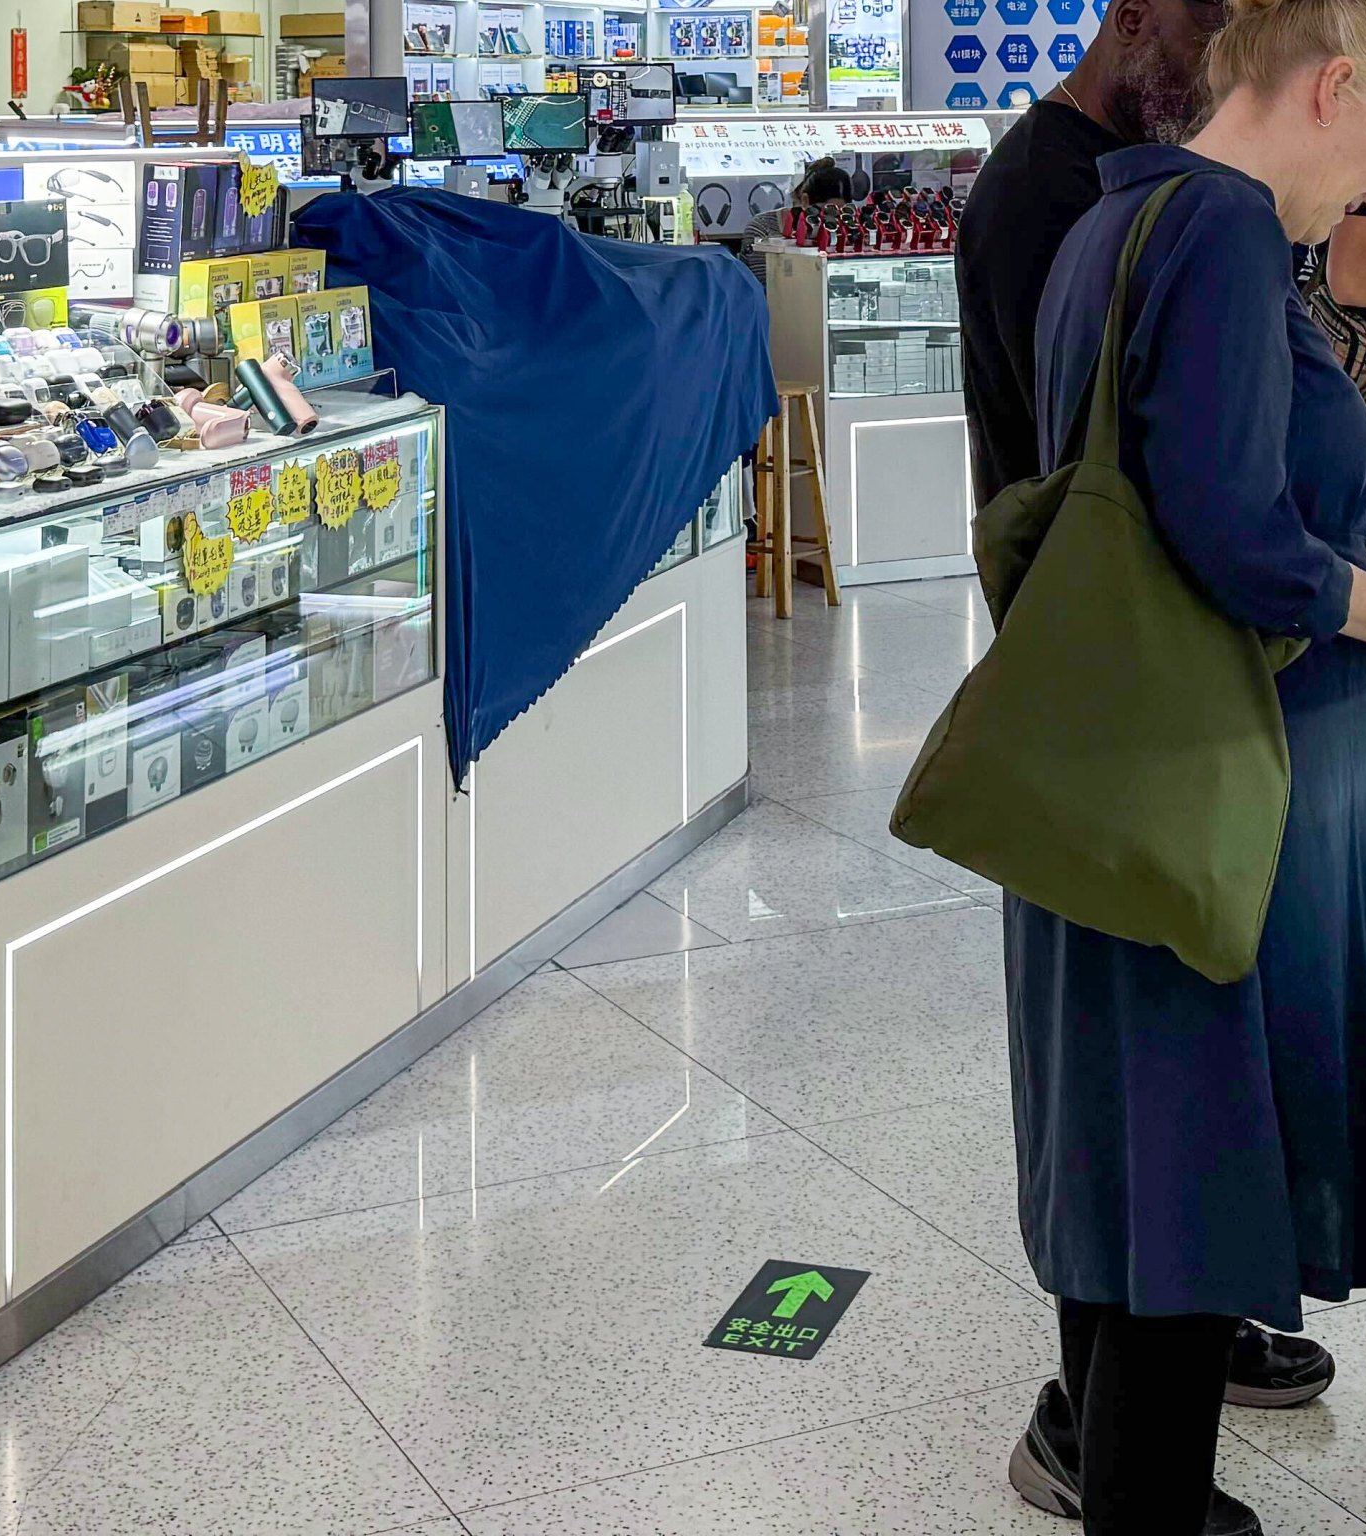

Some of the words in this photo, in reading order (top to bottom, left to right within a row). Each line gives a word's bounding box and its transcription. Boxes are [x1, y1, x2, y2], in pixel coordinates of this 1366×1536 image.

[1007, 1, 1027, 11] 电池
[1062, 2, 1070, 10] IC
[951, 9, 979, 17] 连接器
[1008, 44, 1028, 53] 综合
[1059, 43, 1076, 52] 工业
[1008, 55, 1028, 64] 布线
[835, 122, 967, 138] 手表耳机工厂批发
[727, 1318, 819, 1340] 安全出口
[722, 1334, 804, 1351] EXIT
